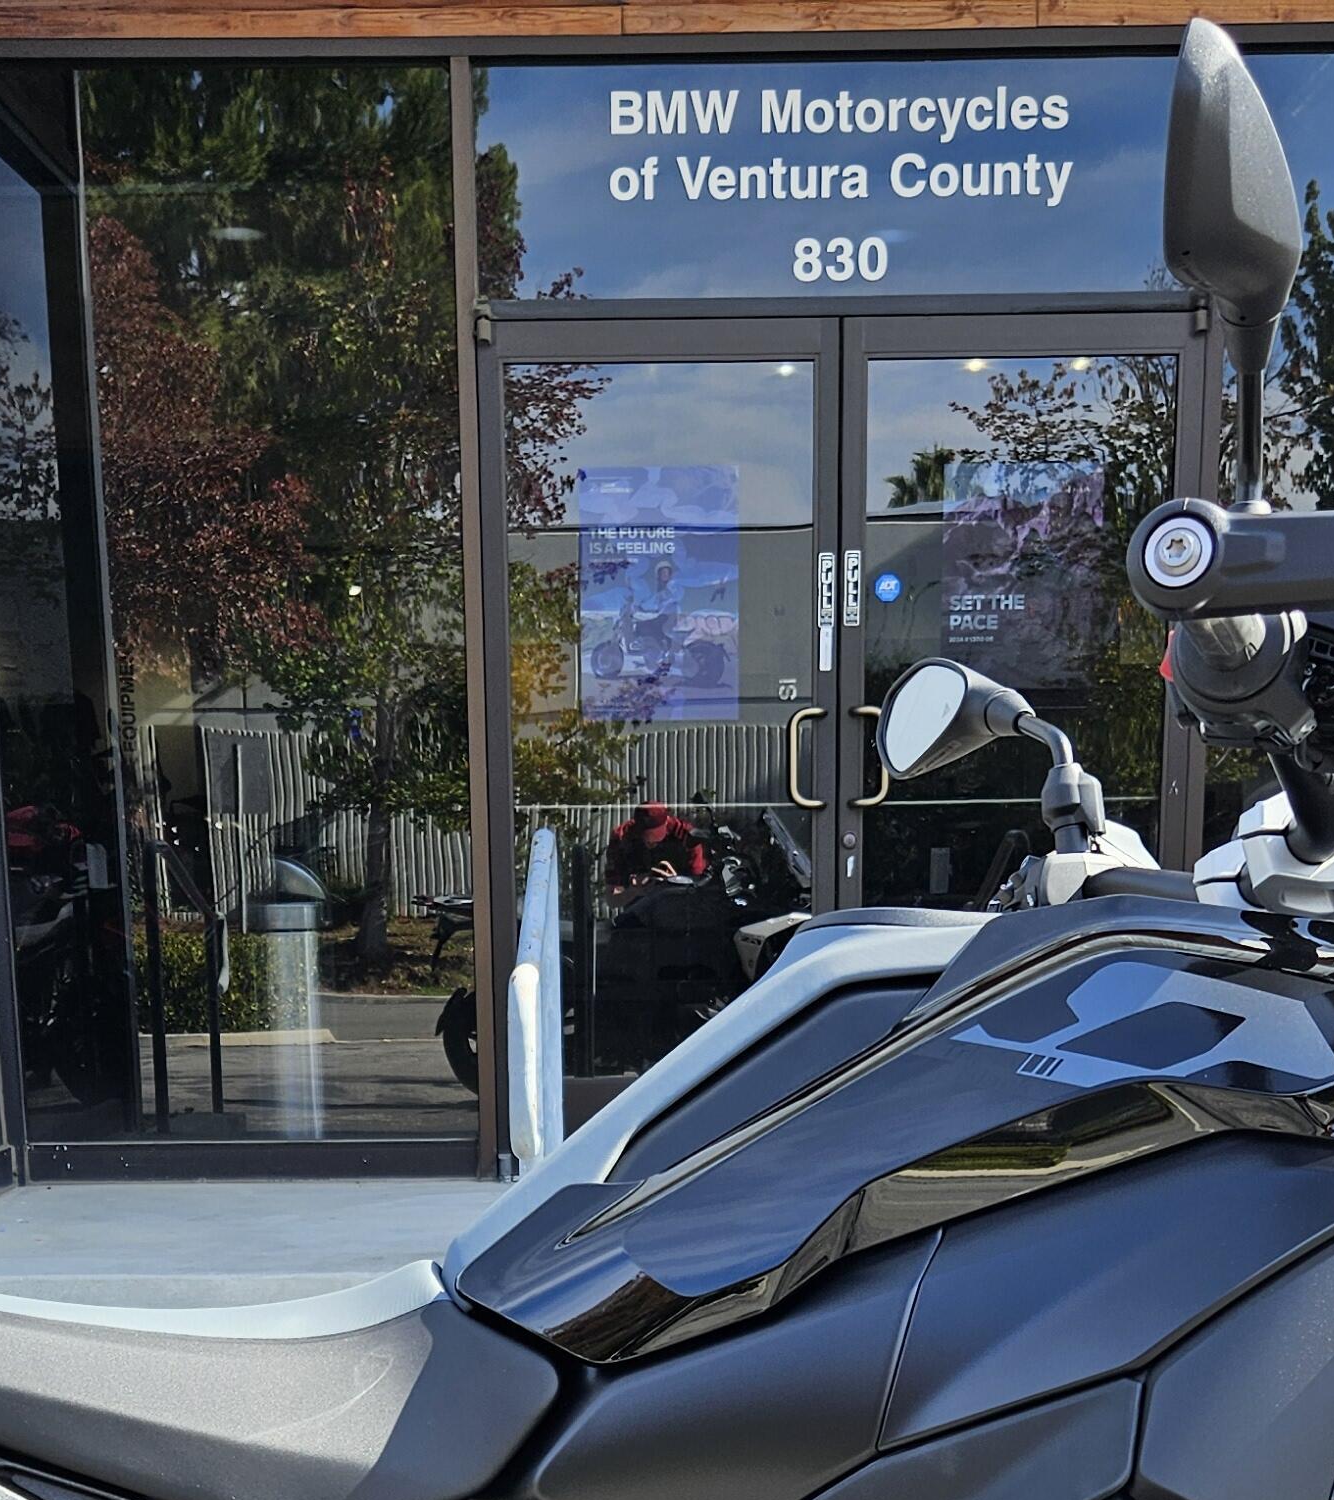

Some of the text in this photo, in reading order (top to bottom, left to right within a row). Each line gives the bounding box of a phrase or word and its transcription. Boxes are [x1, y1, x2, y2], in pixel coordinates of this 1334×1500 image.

[610, 87, 1070, 143] BMW Motorcycles
[610, 153, 1074, 207] of Ventura County
[793, 236, 888, 283] 830
[589, 526, 675, 539] THE FUTURE
[589, 541, 676, 555] IS A FEELING
[821, 560, 833, 609] PULL
[848, 557, 858, 607] PULL
[948, 594, 1026, 611] SET THE
[949, 614, 998, 631] PACE
